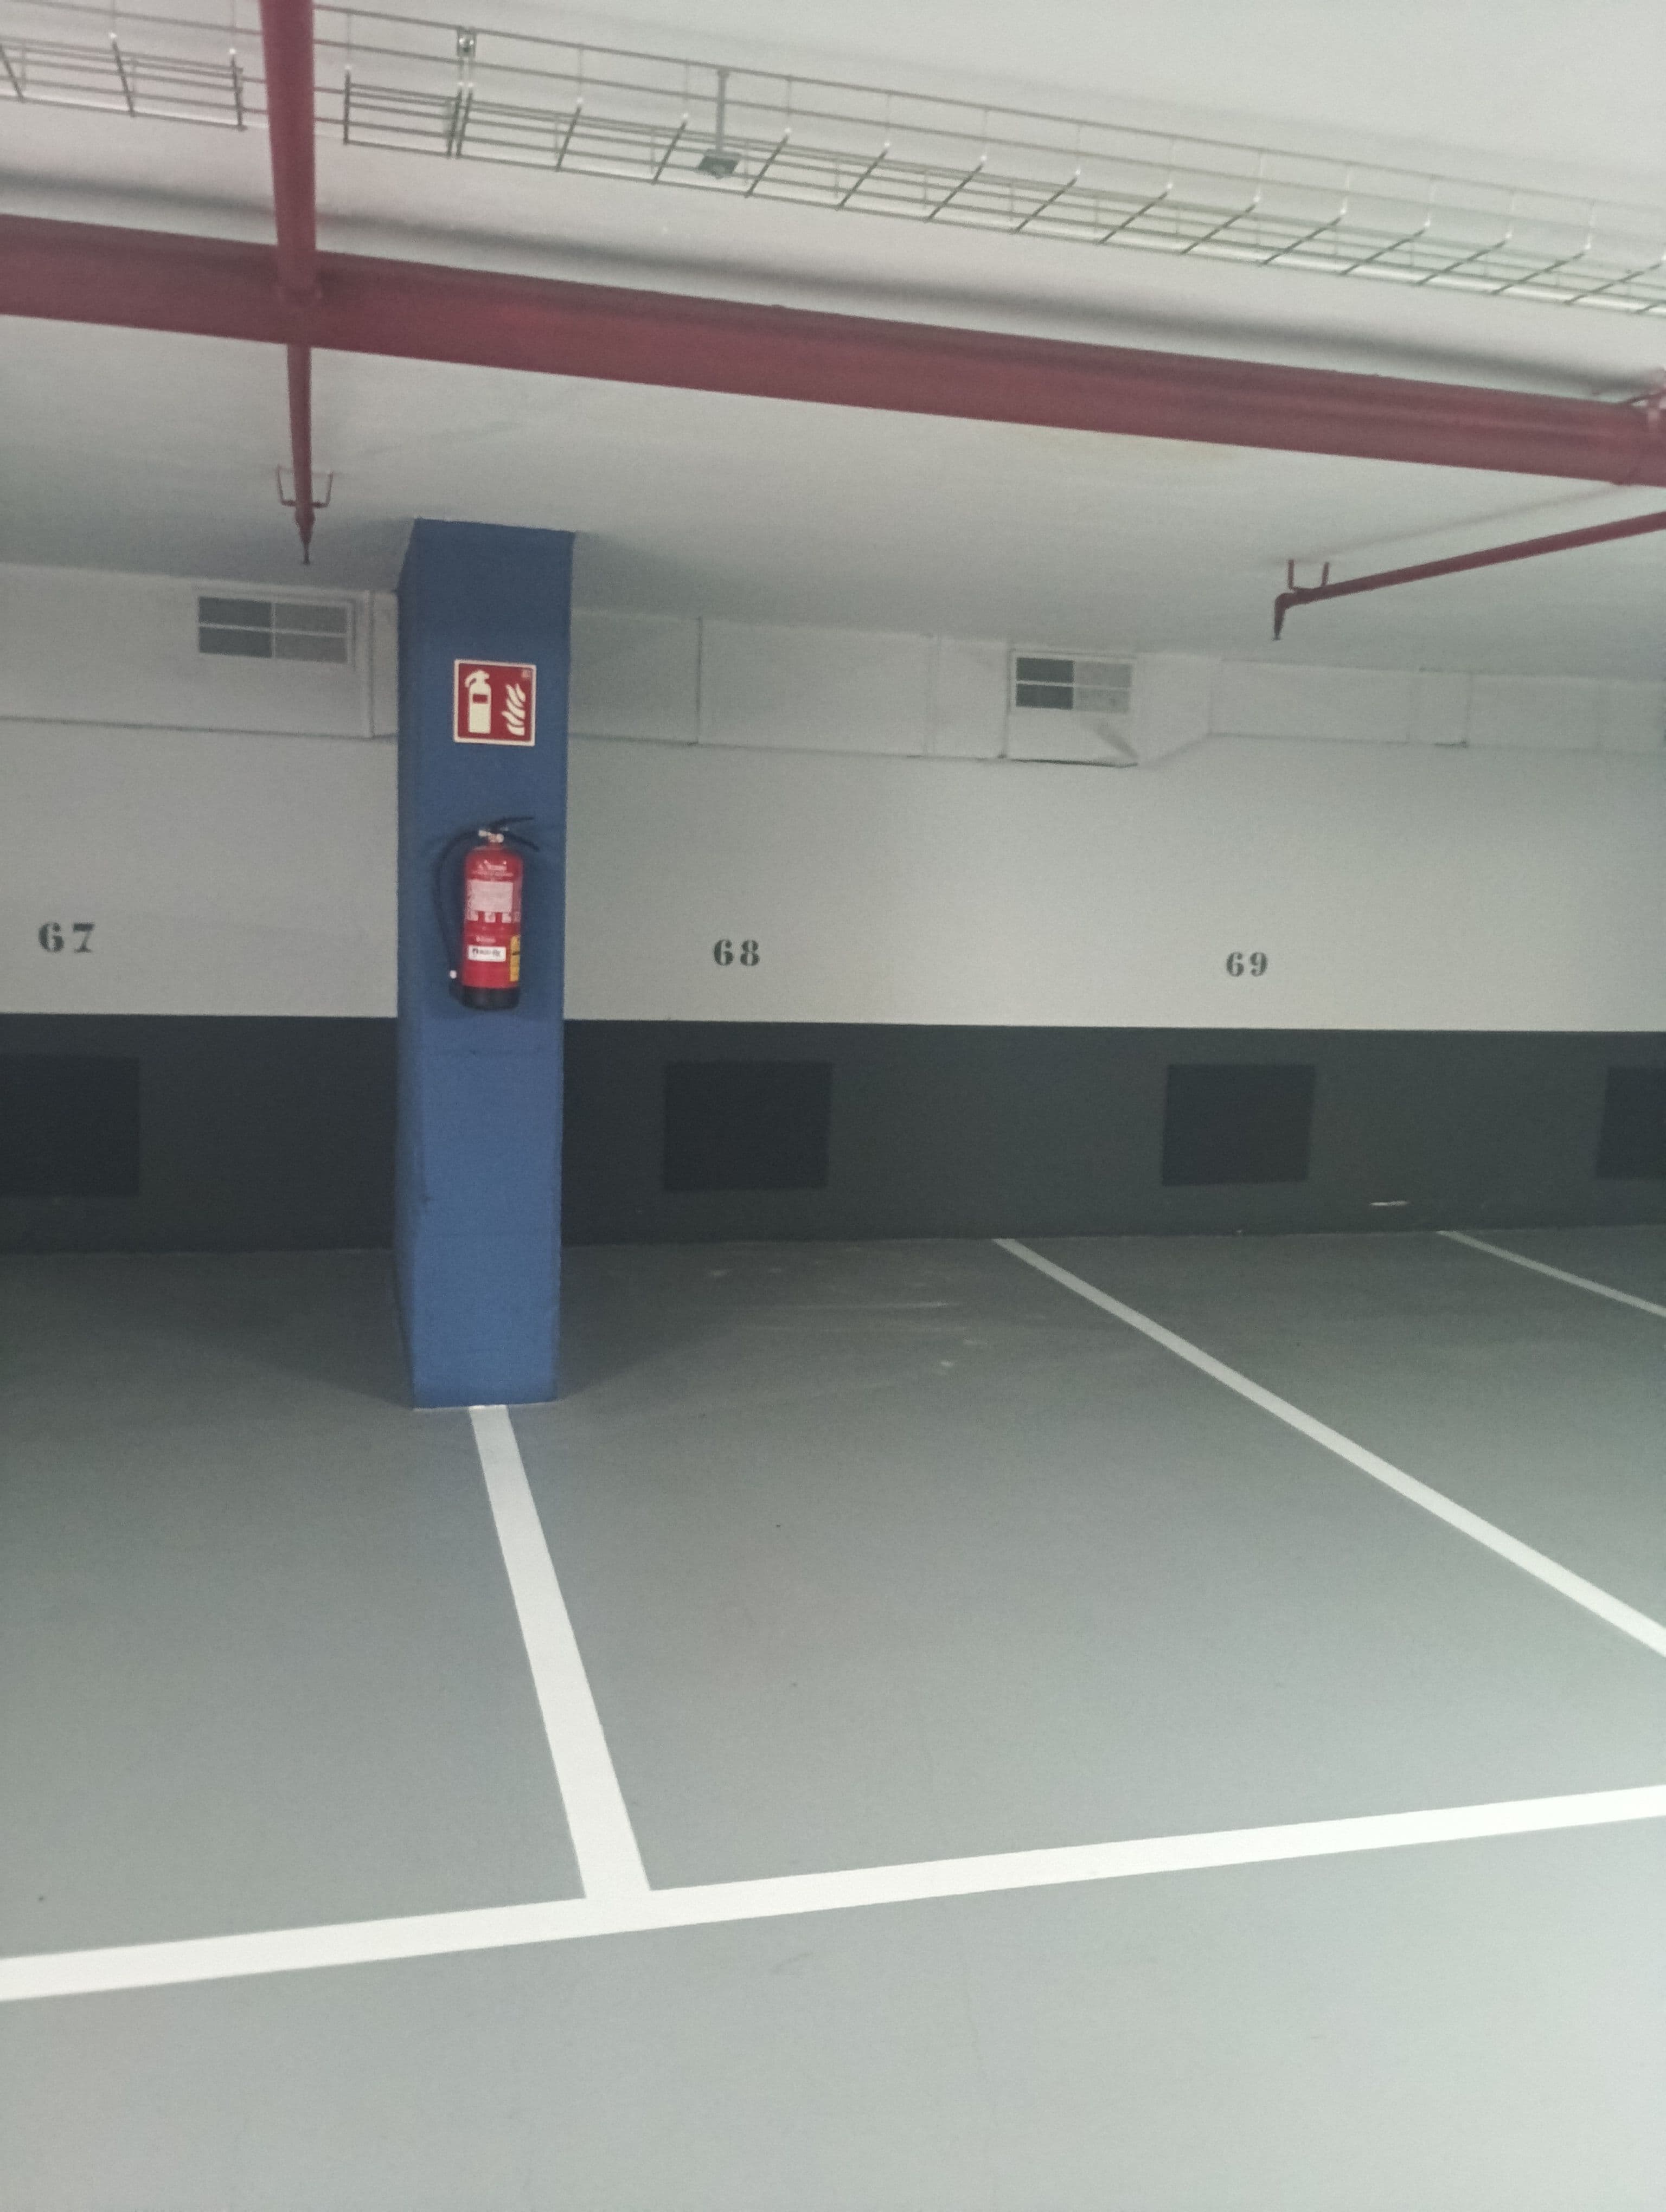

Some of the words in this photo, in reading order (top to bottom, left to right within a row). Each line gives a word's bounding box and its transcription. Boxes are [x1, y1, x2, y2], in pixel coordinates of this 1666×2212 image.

[38, 922, 95, 953] 67
[714, 939, 760, 966] 68
[1226, 952, 1267, 976] 69
